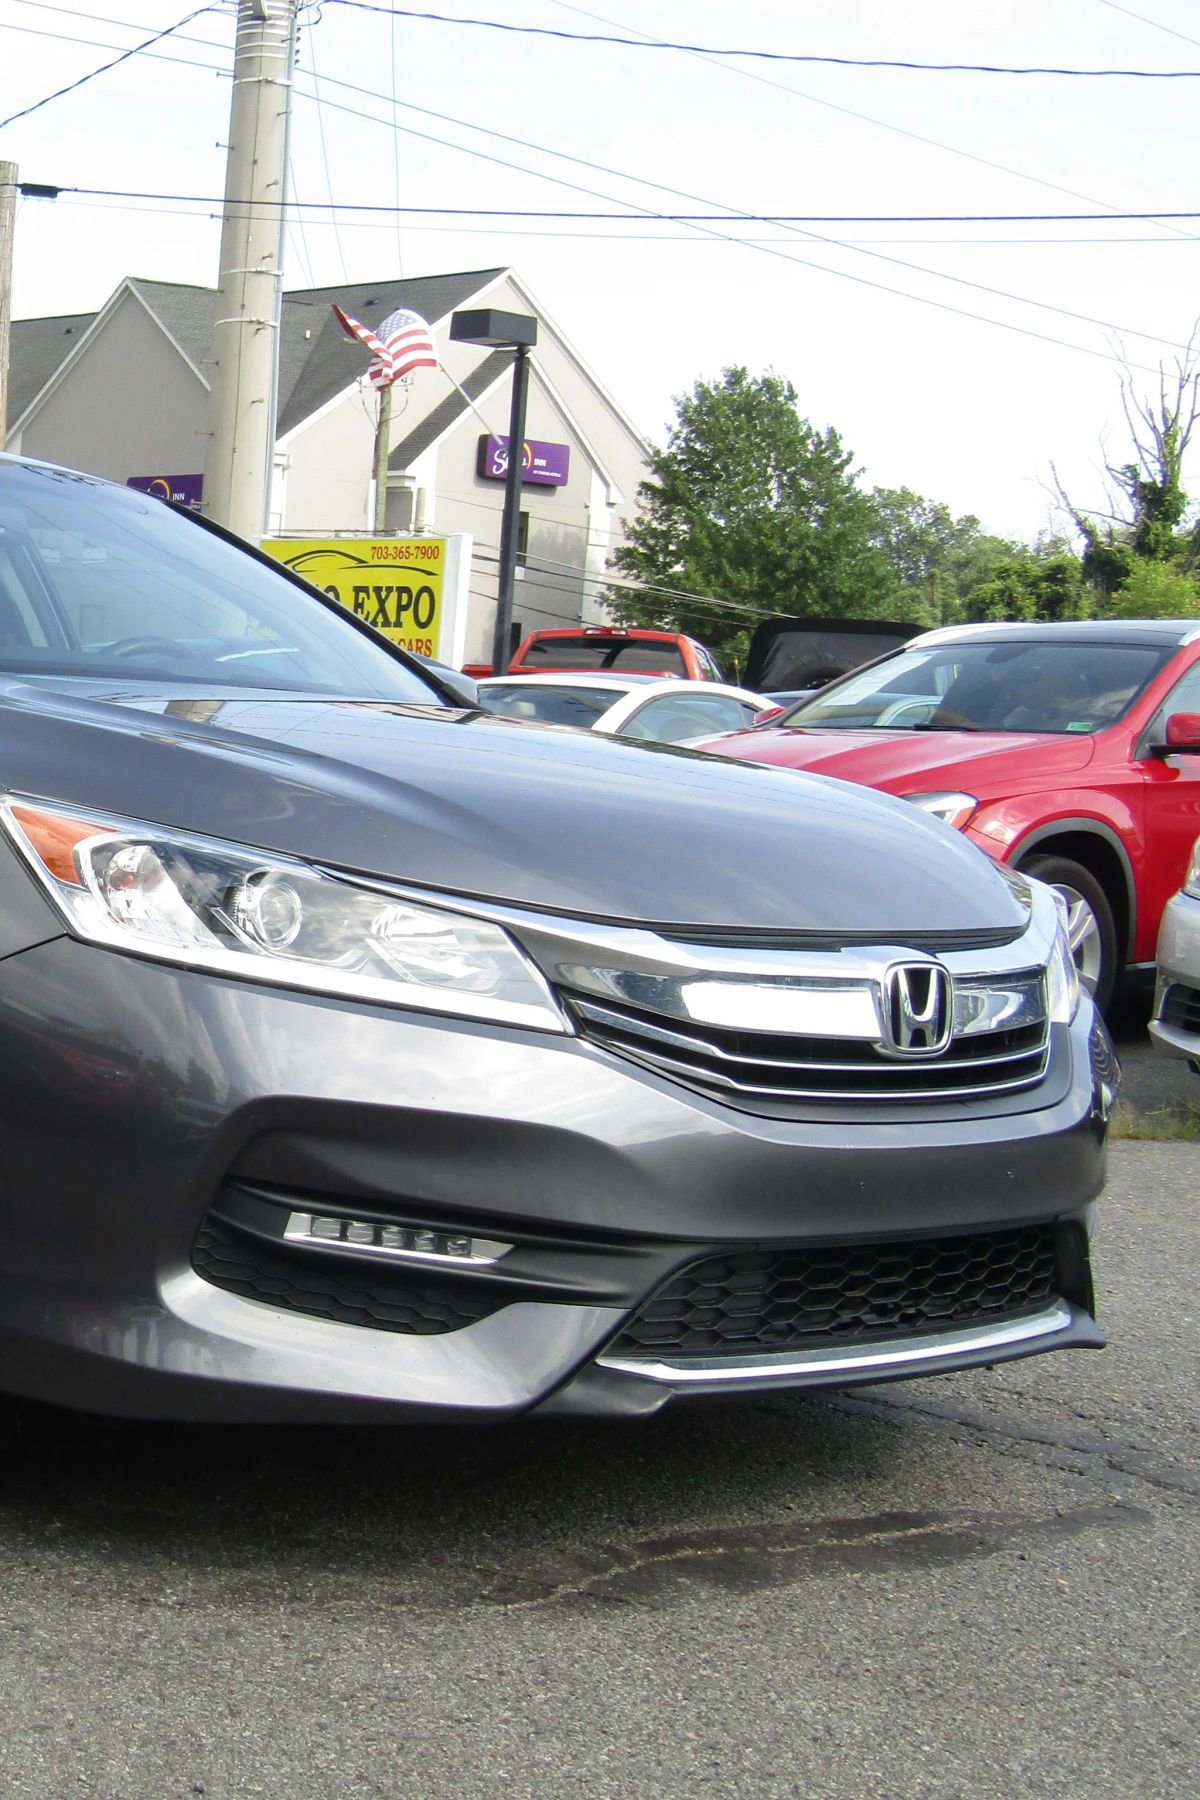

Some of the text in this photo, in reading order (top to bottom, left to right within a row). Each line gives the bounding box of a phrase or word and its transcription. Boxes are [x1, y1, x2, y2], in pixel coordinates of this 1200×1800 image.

[172, 493, 185, 501] INN
[370, 545, 440, 560] 703-365-7900
[352, 585, 436, 630] EXPO
